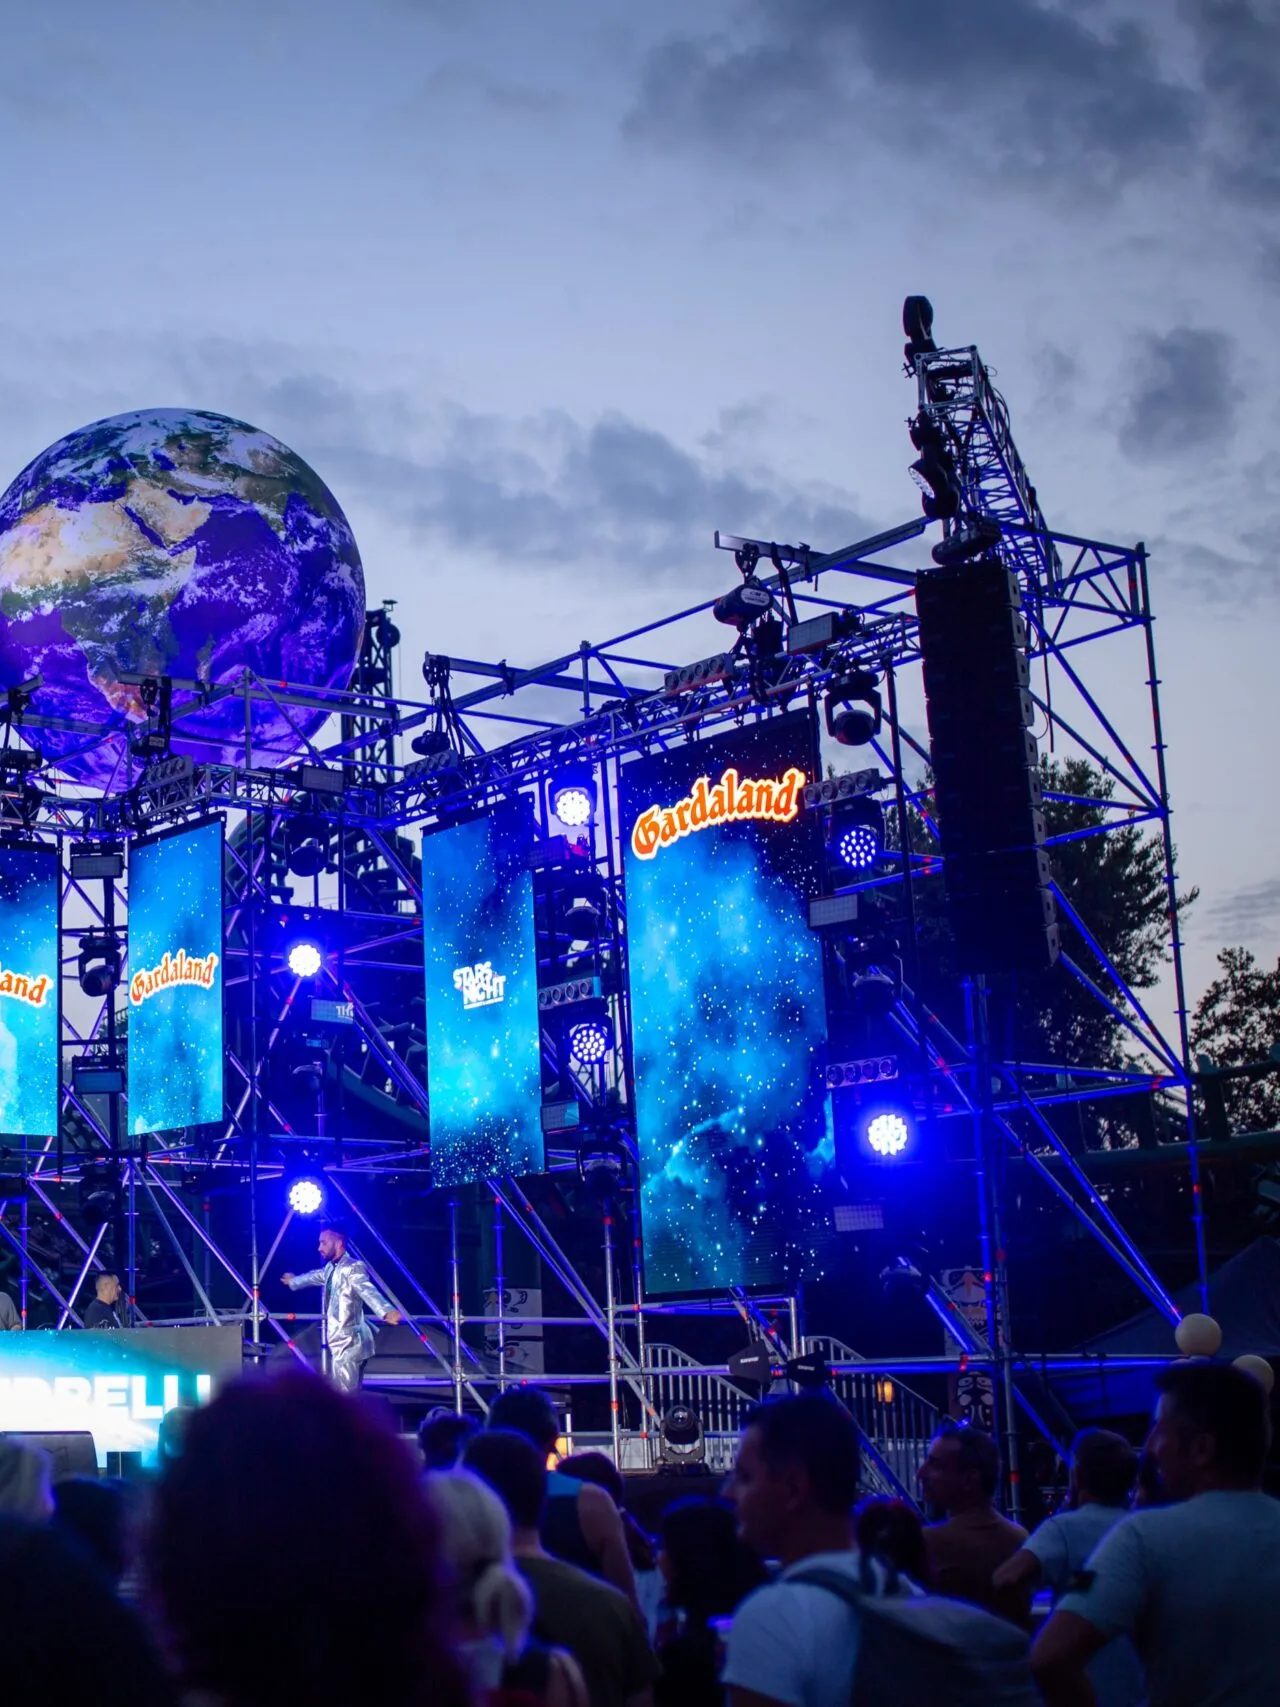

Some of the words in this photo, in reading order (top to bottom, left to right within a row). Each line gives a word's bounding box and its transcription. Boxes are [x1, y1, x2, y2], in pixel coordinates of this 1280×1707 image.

[632, 768, 806, 860] Gardaland
[130, 948, 218, 1005] Gardaland
[453, 961, 492, 988] STARS
